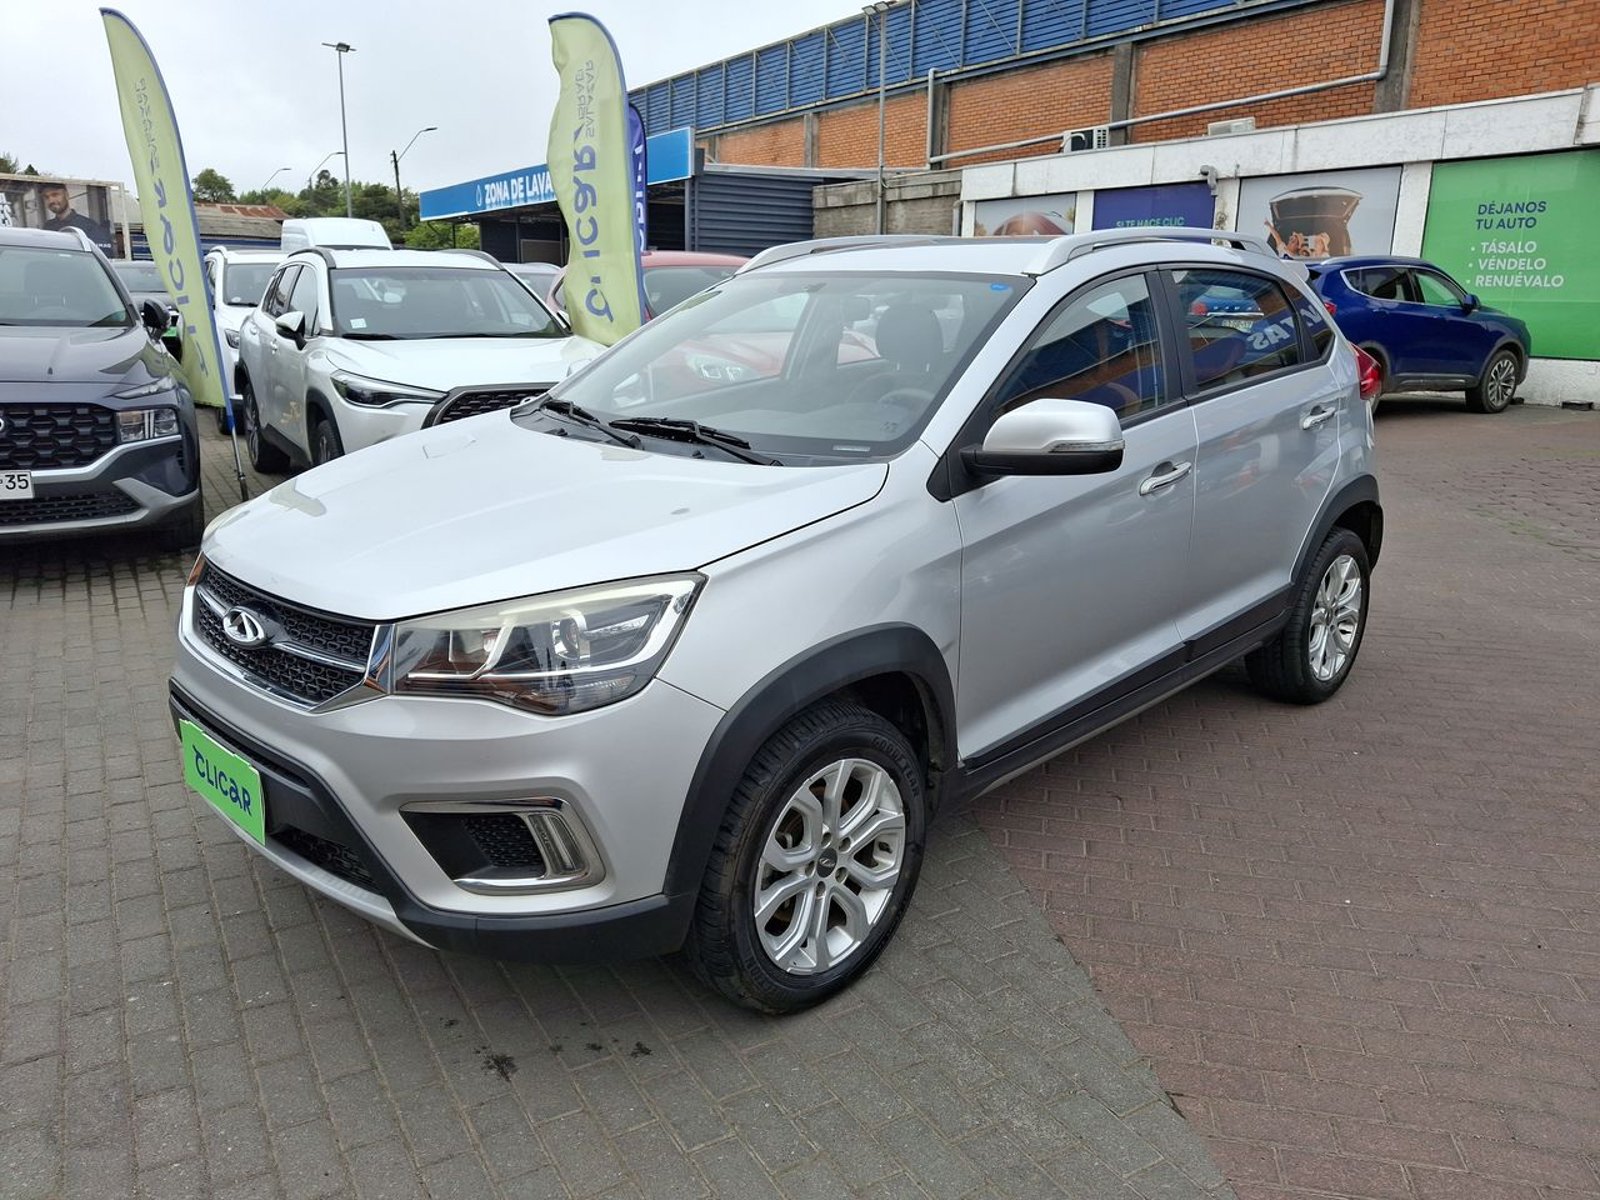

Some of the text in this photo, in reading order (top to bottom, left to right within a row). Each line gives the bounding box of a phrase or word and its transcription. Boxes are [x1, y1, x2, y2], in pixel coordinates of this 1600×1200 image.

[484, 181, 510, 204] ZONA
[510, 176, 525, 200] DE
[1477, 200, 1547, 216] DÉJANOS
[1162, 216, 1185, 227] CLIC
[1475, 216, 1537, 230] TU AUTO
[1480, 238, 1537, 254] TÁSALO
[1478, 255, 1547, 271] VÉNDELO
[1475, 272, 1565, 288] RENUÉVALO
[4, 473, 29, 490] 35
